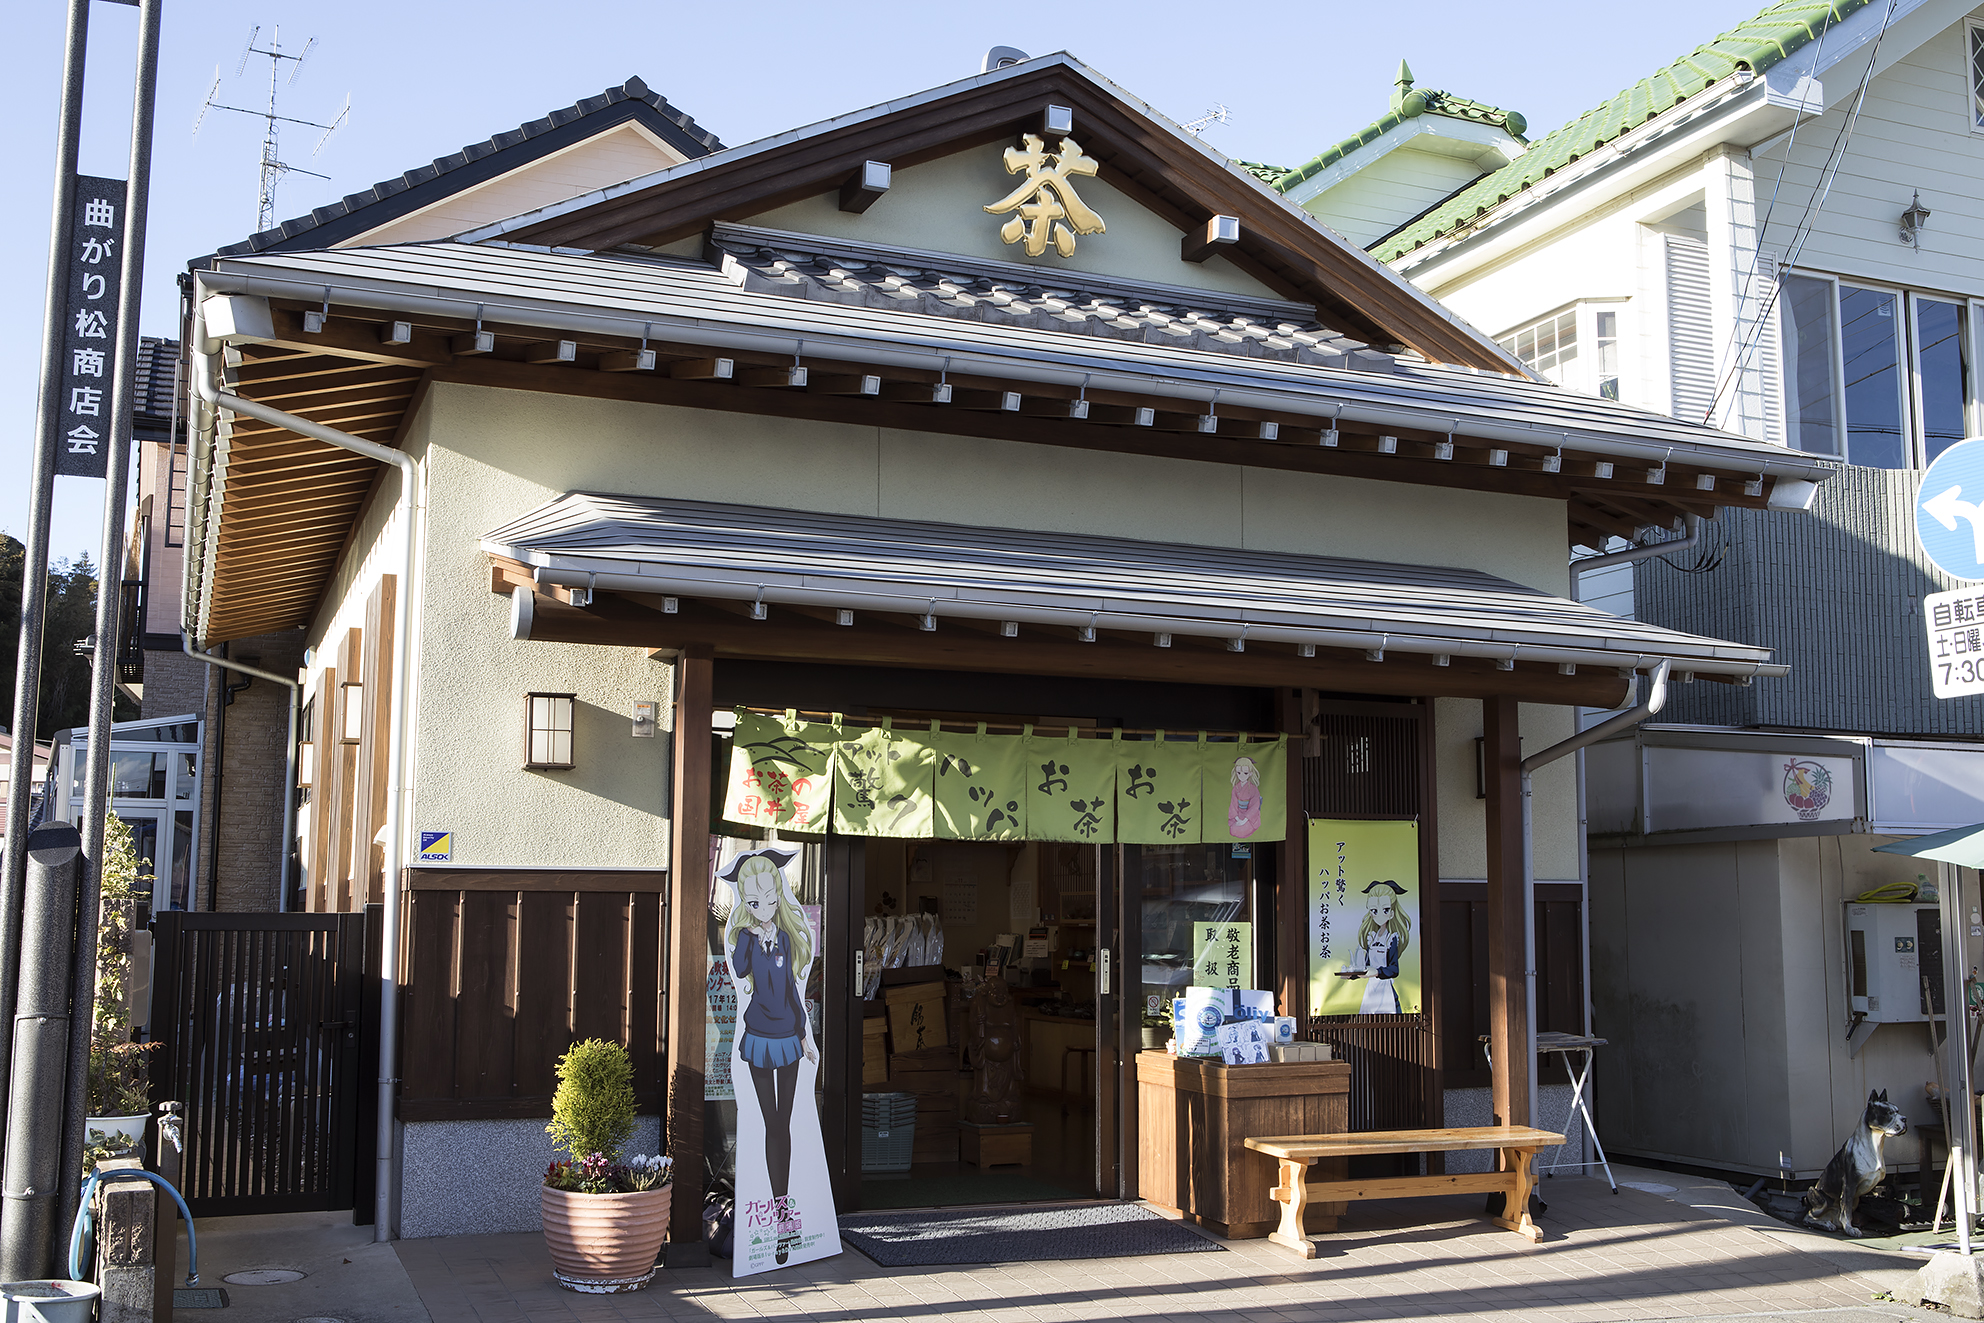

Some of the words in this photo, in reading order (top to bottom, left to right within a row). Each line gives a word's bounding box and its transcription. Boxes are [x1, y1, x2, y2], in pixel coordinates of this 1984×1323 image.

[982, 133, 1106, 258] 茶
[67, 197, 114, 455] 曲がり松商店会
[737, 795, 810, 825] 国井屋
[742, 767, 812, 795] お茶の
[939, 753, 1019, 832] ハッパ
[1037, 759, 1106, 838] お茶
[1125, 763, 1192, 839] お茶
[1335, 841, 1347, 906] アット驚く
[1318, 868, 1332, 959] ハッパお茶お茶
[1226, 927, 1241, 990] 敬老商品
[748, 1209, 801, 1228] パンツァー
